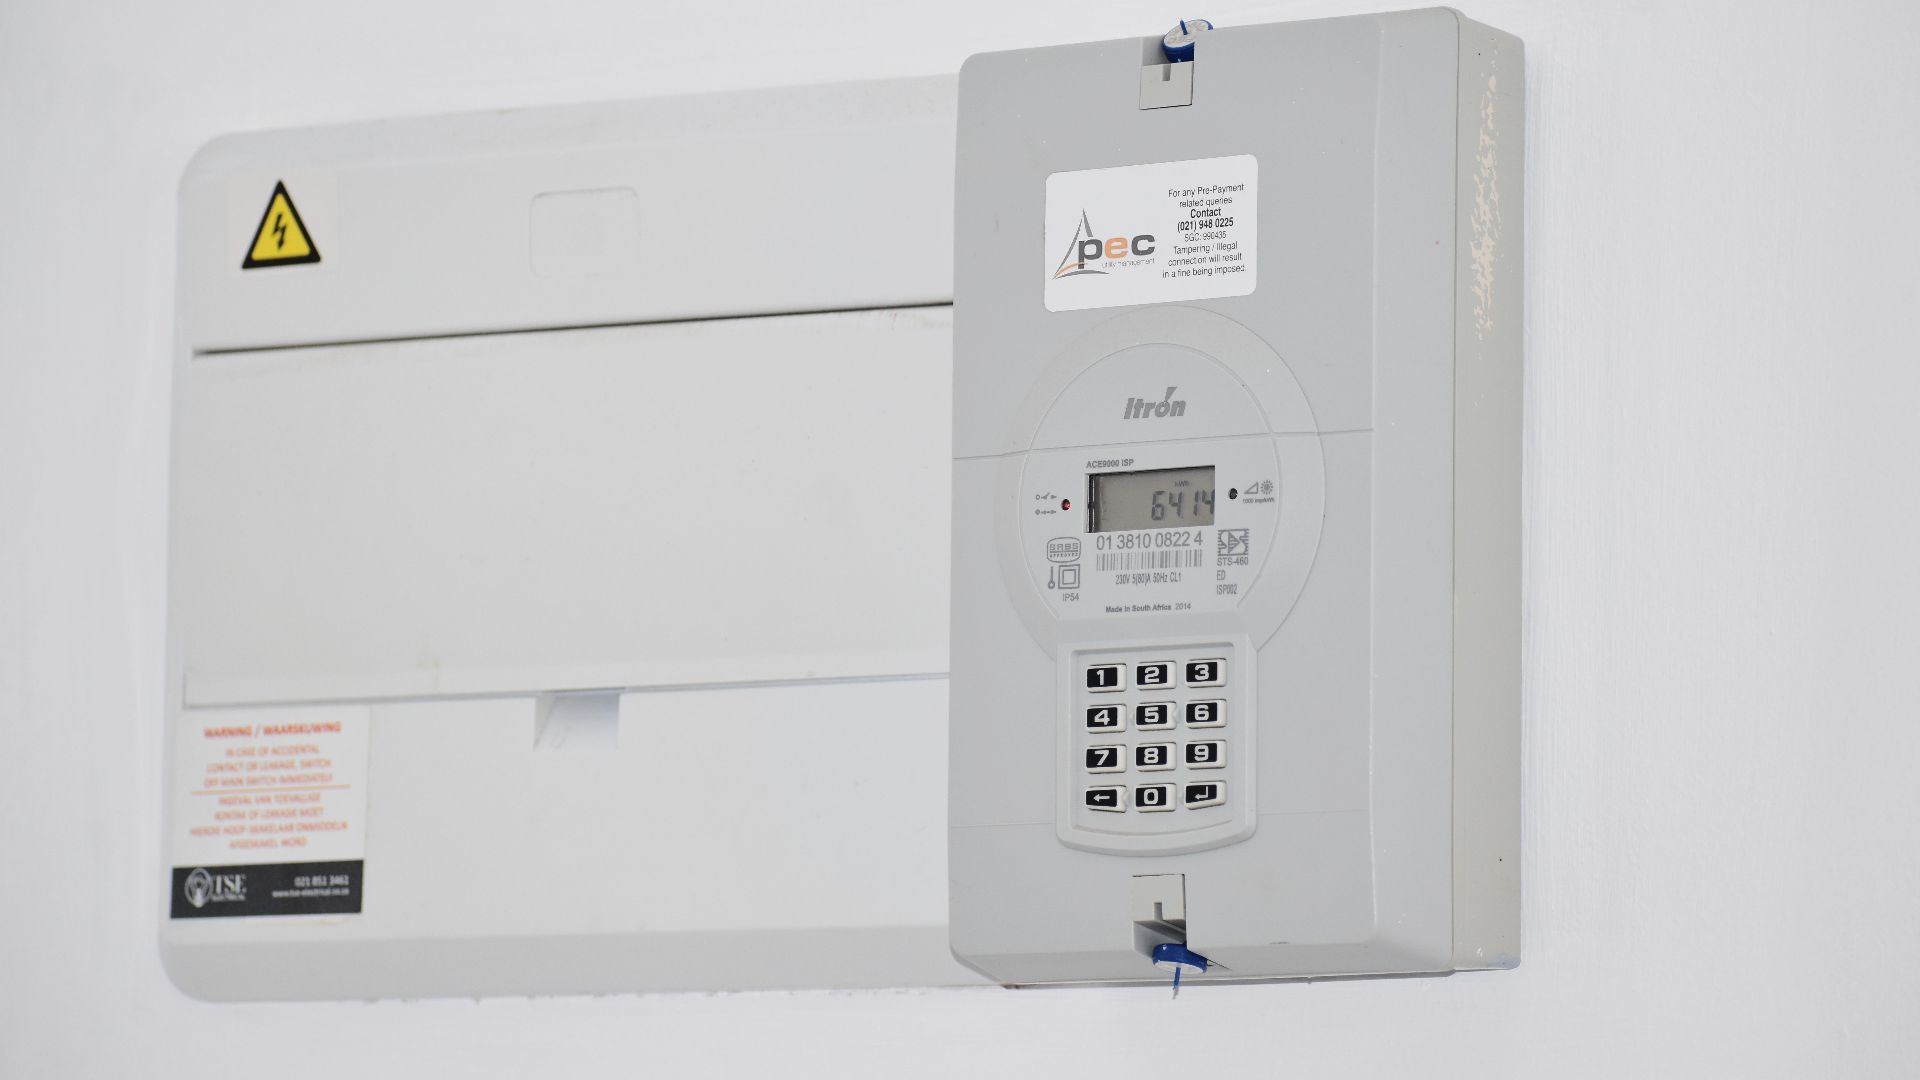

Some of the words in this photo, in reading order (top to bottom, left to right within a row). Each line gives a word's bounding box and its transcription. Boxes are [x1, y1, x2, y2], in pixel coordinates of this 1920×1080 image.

[1168, 189, 1180, 198] For
[1182, 188, 1195, 197] any
[1197, 183, 1244, 195] Pre-Payment
[1179, 199, 1204, 208] related
[1206, 196, 1233, 207] queries
[1190, 207, 1221, 218] Contact
[1177, 220, 1197, 233] (021)
[1198, 218, 1213, 229] 948
[1215, 217, 1234, 228] 0225
[1173, 243, 1210, 255] Tampering
[1216, 240, 1238, 251] Illegal
[1208, 253, 1221, 263] will
[1222, 252, 1242, 262] result
[1162, 268, 1169, 278] in
[1177, 268, 1191, 277] fine
[1192, 267, 1213, 277] being
[1123, 386, 1186, 419] Itron
[1086, 460, 1120, 469] ACE9000
[1121, 458, 1134, 467] ISP
[1049, 542, 1079, 551] SABS
[1096, 535, 1112, 550] 01
[1116, 532, 1151, 549] 3810
[1155, 531, 1191, 548] 0822
[1193, 530, 1203, 546] 4
[1216, 556, 1249, 566] STS-460
[1115, 573, 1131, 584] 230V
[1216, 584, 1238, 595] ISP002
[1062, 593, 1080, 603] IP54
[1105, 605, 1123, 613] Made
[1131, 604, 1151, 612] South
[1152, 603, 1172, 611] Africa
[1175, 602, 1191, 610] 2014
[1096, 669, 1105, 686] 1
[1144, 666, 1160, 684] 2
[1194, 664, 1210, 681] 3
[1094, 709, 1110, 726] 4
[1144, 706, 1159, 723] 5
[1194, 704, 1210, 721] 6
[203, 725, 253, 738] WARNING
[262, 721, 342, 735] WAARSKUWING
[1094, 750, 1110, 766] 7
[1143, 747, 1159, 764] 8
[1194, 744, 1209, 761] 9
[1143, 788, 1159, 805] 0
[212, 873, 247, 895] TSE
